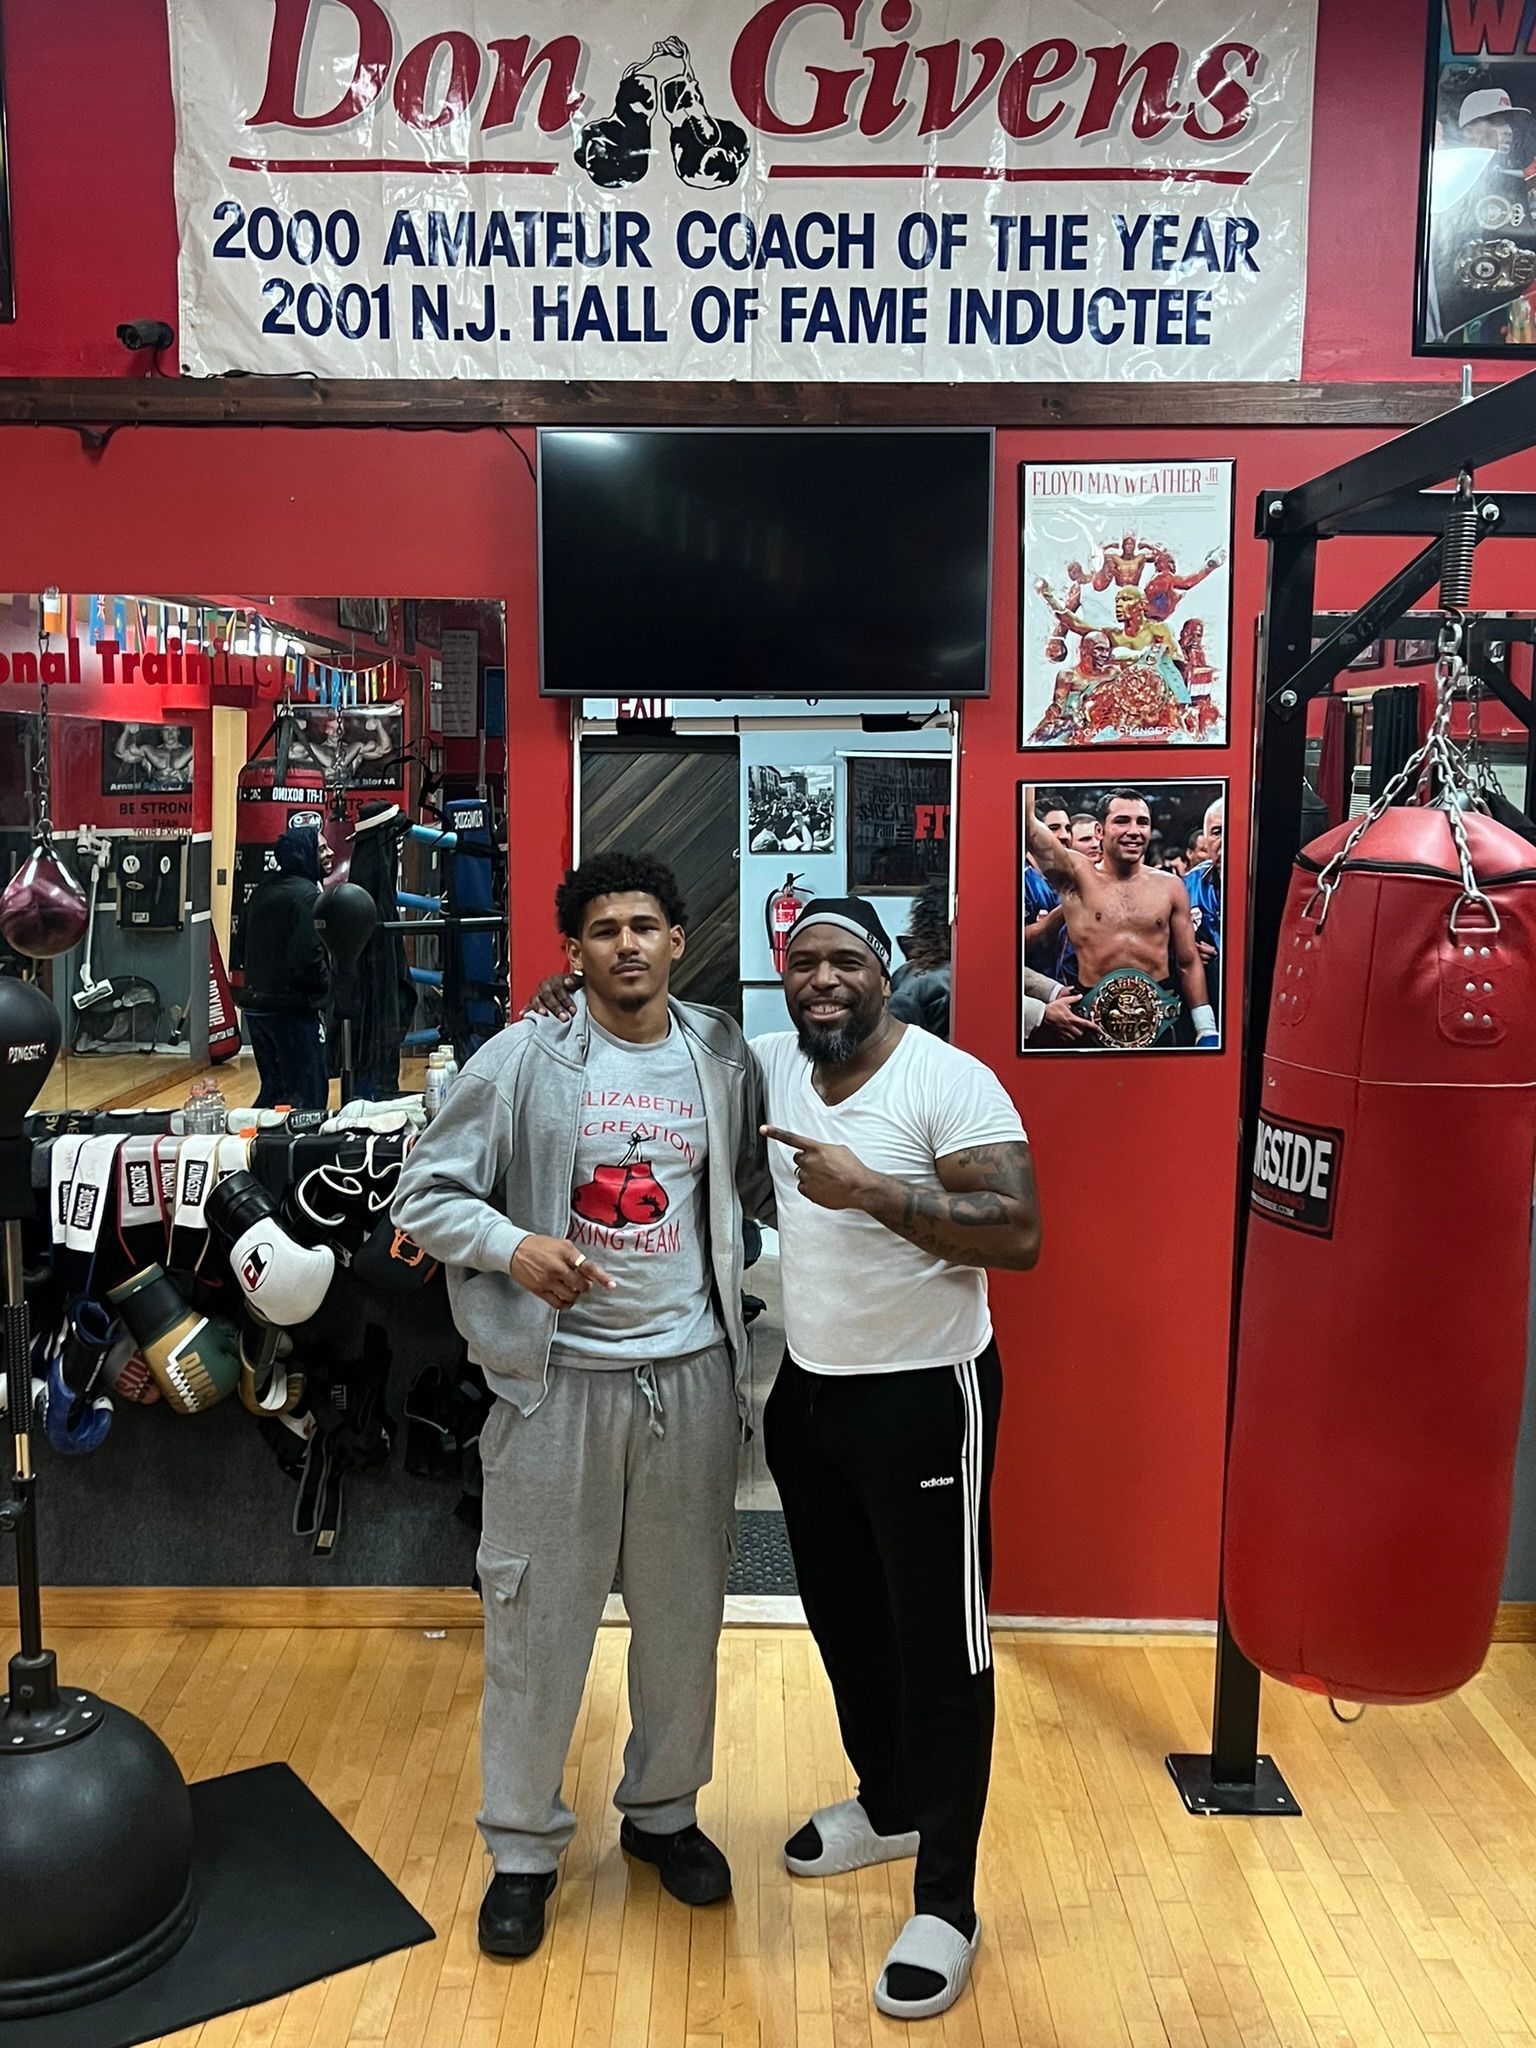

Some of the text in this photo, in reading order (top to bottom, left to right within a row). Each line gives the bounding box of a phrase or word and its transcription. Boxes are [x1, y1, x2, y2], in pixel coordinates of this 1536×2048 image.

[1449, 0, 1536, 55] W
[247, 0, 1259, 141] Don Givens
[213, 201, 1261, 273] 2000 AMATEUR COACH OF THE YEAR
[262, 278, 1212, 346] 2001 N.J. HALL OF FAME INDUCTEE
[1032, 471, 1083, 496] FLOYD
[1088, 468, 1201, 496] MAYWEATHER
[96, 637, 284, 698] Training
[580, 1091, 694, 1118] LIZABETH
[633, 1219, 682, 1254] TEAM
[920, 1476, 955, 1489] adidas
